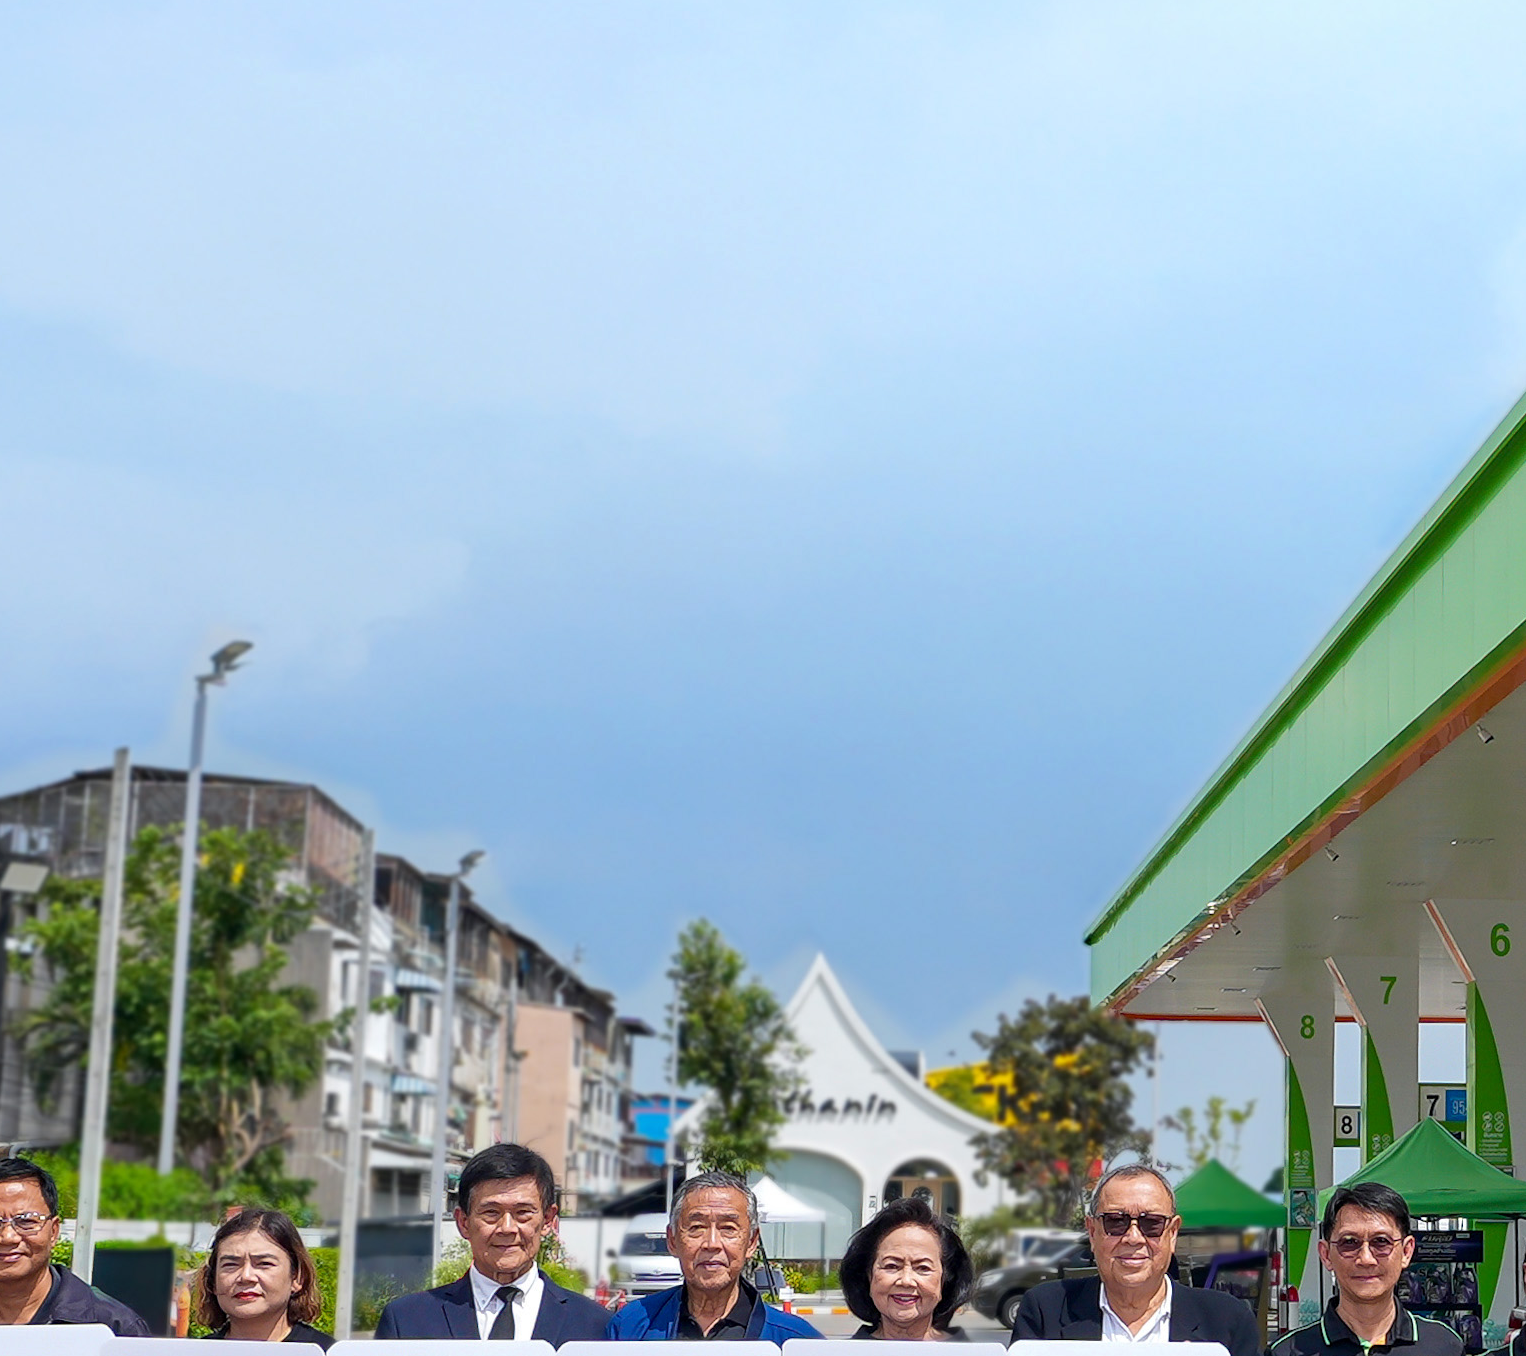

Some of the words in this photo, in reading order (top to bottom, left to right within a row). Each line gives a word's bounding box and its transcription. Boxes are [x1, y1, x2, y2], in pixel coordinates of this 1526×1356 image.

[1490, 923, 1511, 957] 6
[1380, 977, 1397, 1005] 7
[1300, 1014, 1316, 1040] 8
[783, 1089, 897, 1117] thanin
[1426, 1095, 1440, 1117] 7
[1341, 1115, 1352, 1134] 8
